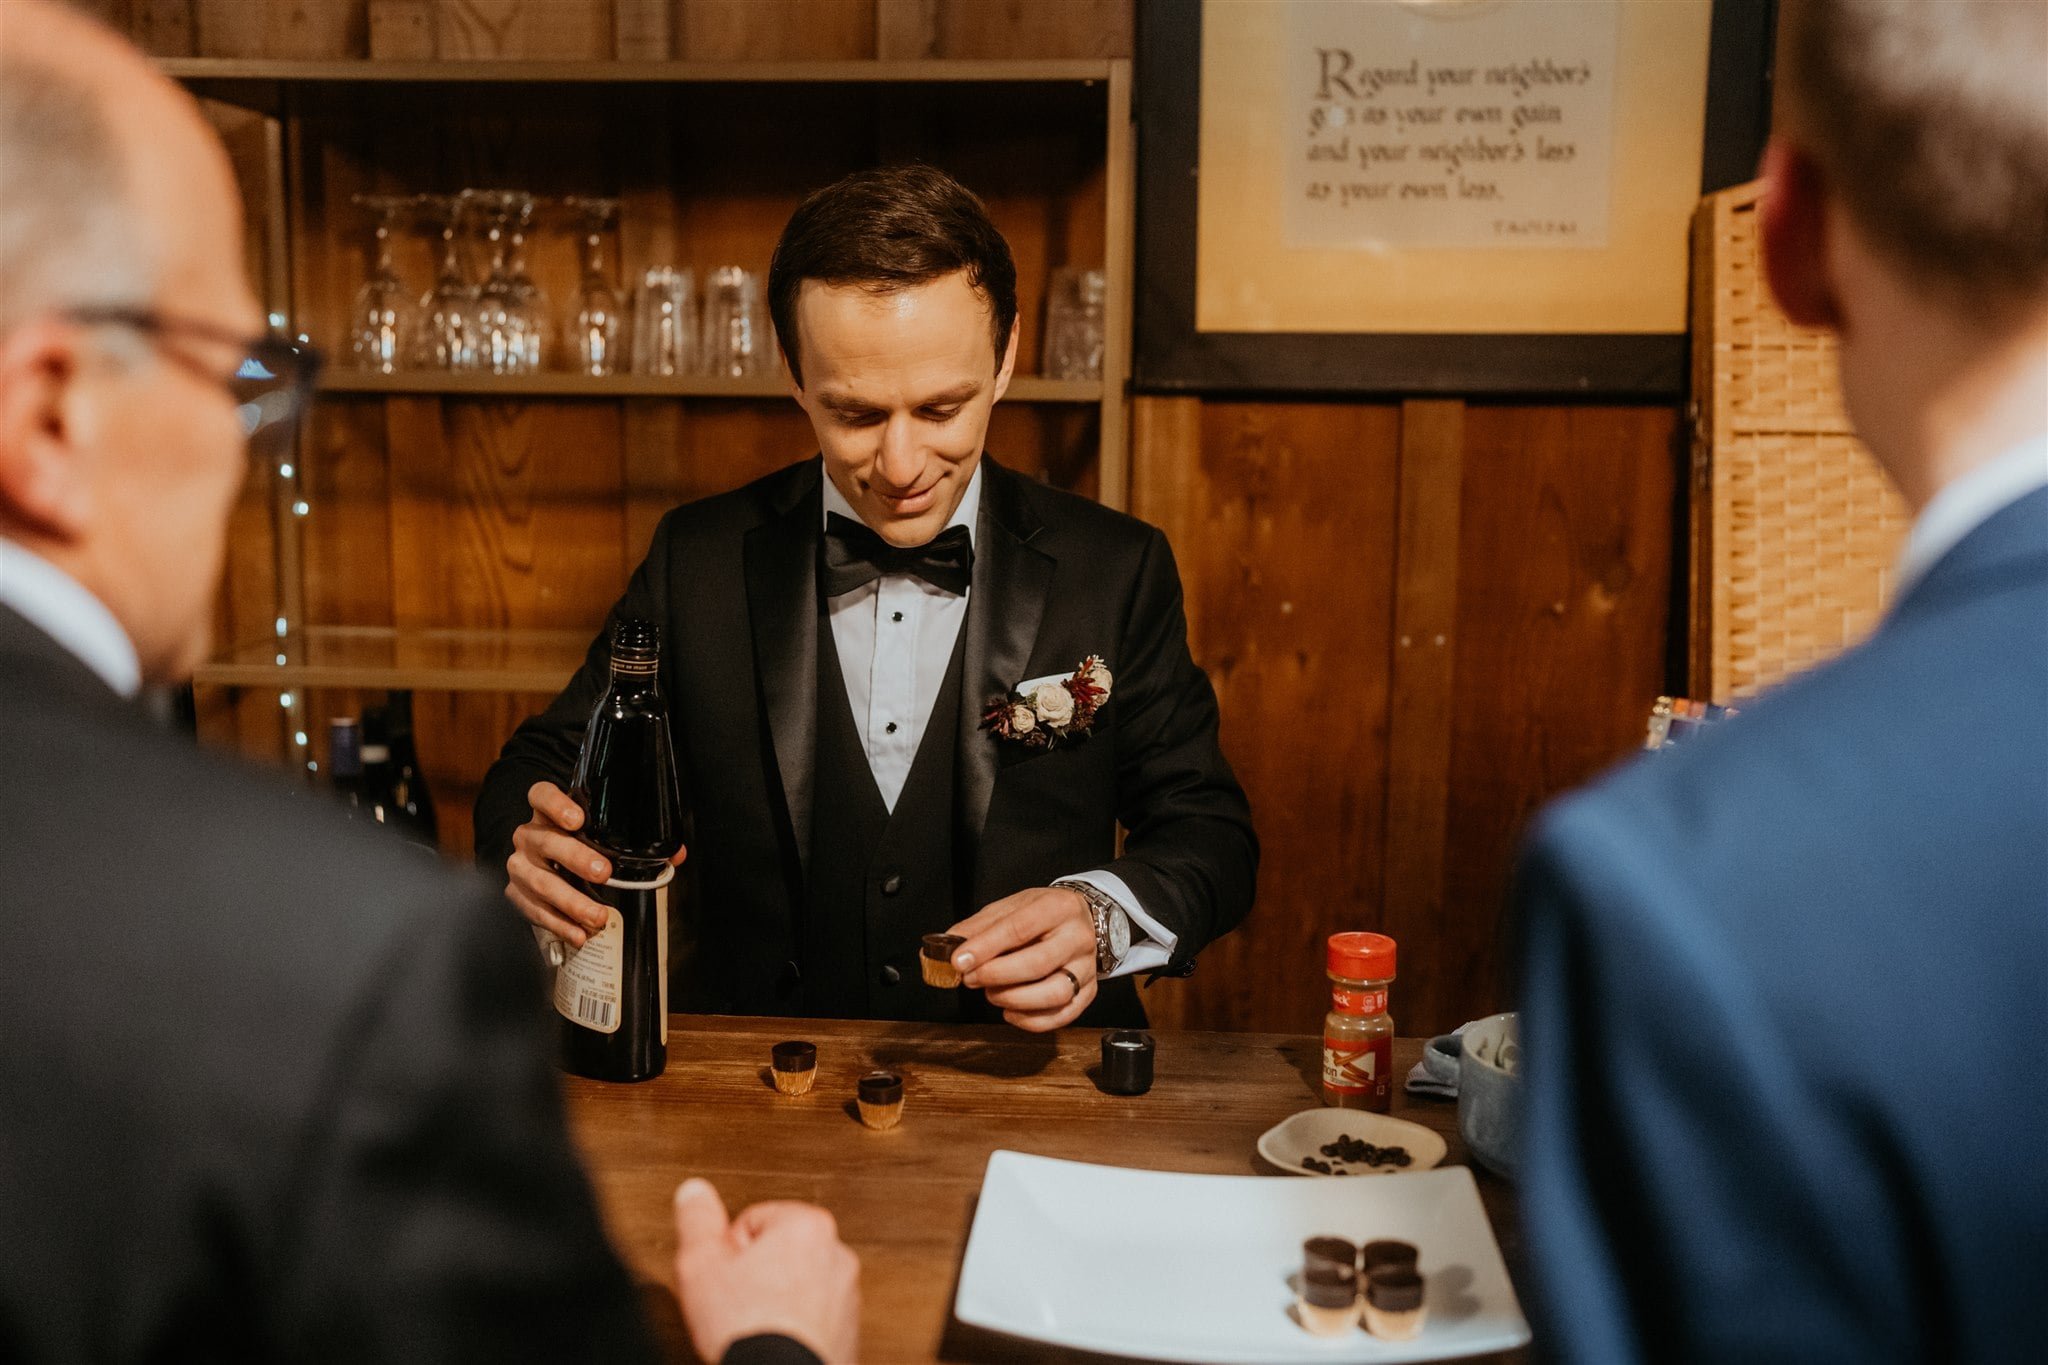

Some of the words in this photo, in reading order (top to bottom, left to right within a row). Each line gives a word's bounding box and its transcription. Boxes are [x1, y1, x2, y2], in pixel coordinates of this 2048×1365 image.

[1313, 47, 1419, 99] Regard
[1427, 68, 1475, 96] your
[1362, 105, 1388, 124] as
[1395, 105, 1446, 134] your
[1454, 105, 1502, 124] own
[1508, 104, 1562, 135] gain
[1306, 135, 1349, 162] and
[1358, 143, 1409, 170] your
[1305, 181, 1331, 200] as
[1340, 182, 1391, 208] your
[1400, 182, 1448, 200] own
